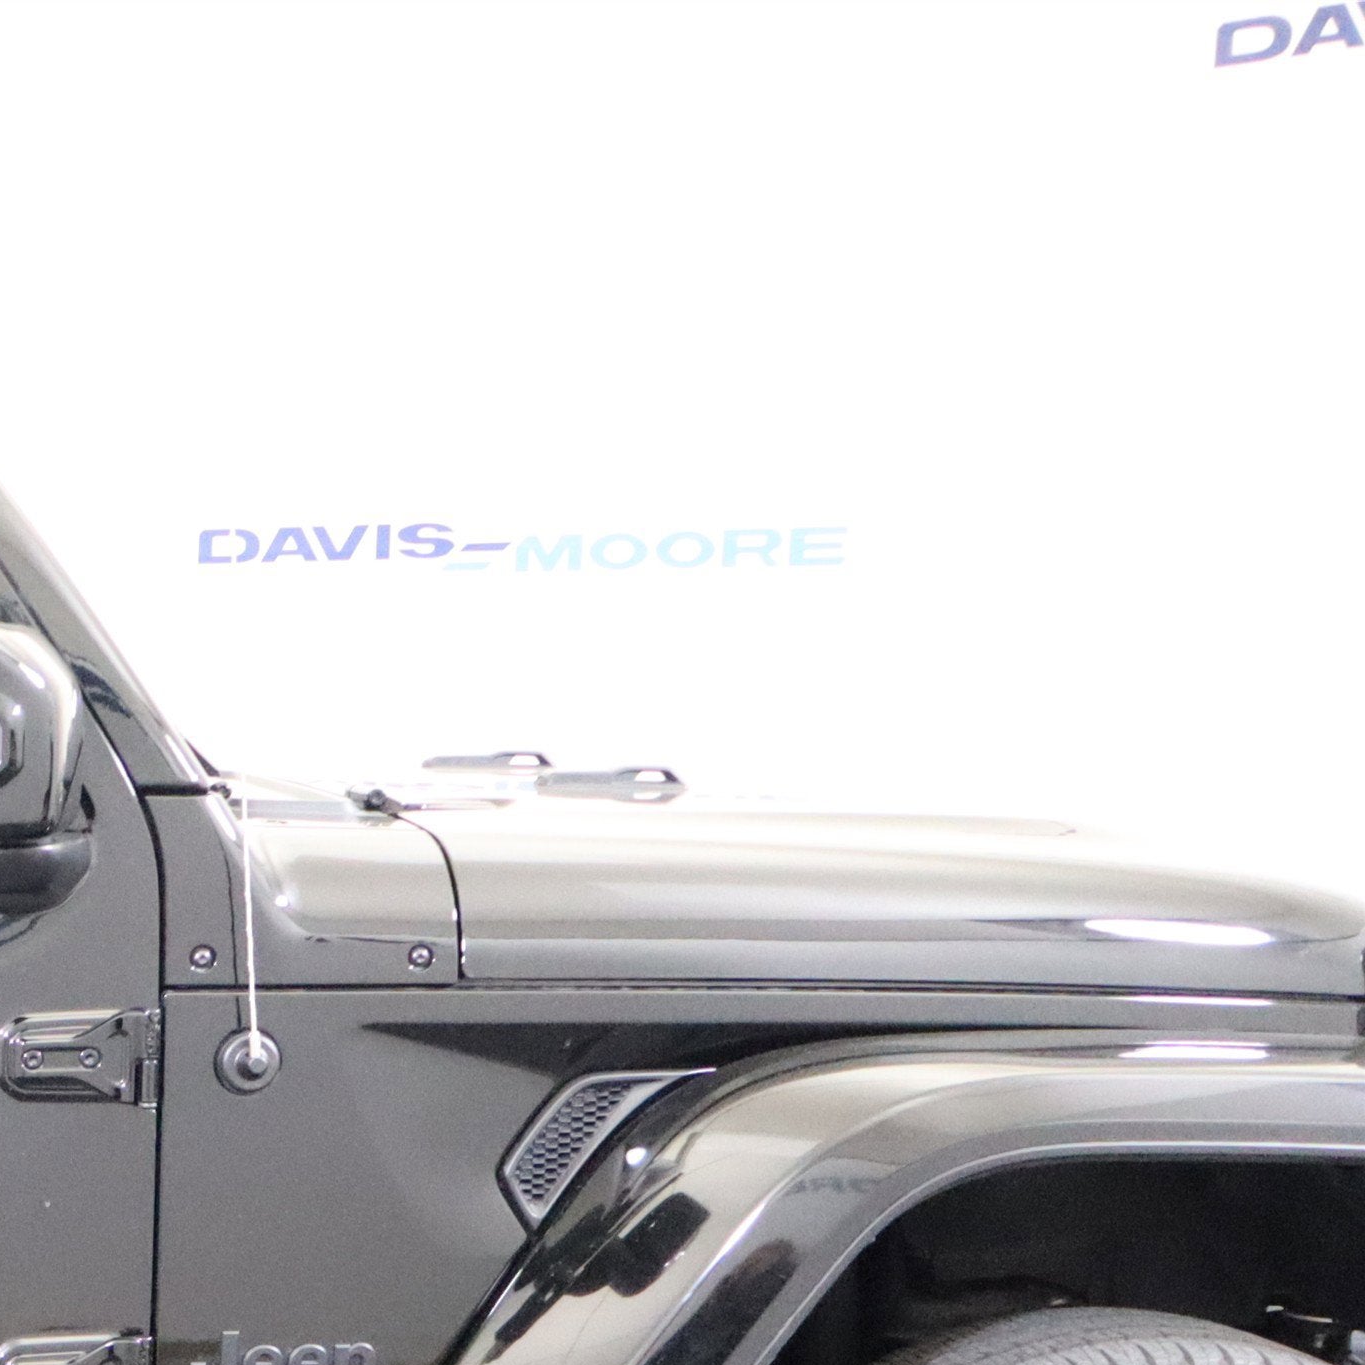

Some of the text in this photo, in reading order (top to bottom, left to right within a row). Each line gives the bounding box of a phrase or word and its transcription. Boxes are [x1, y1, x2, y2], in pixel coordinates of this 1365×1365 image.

[1214, 0, 1365, 67] DA
[198, 523, 848, 573] DAVIS MOORE
